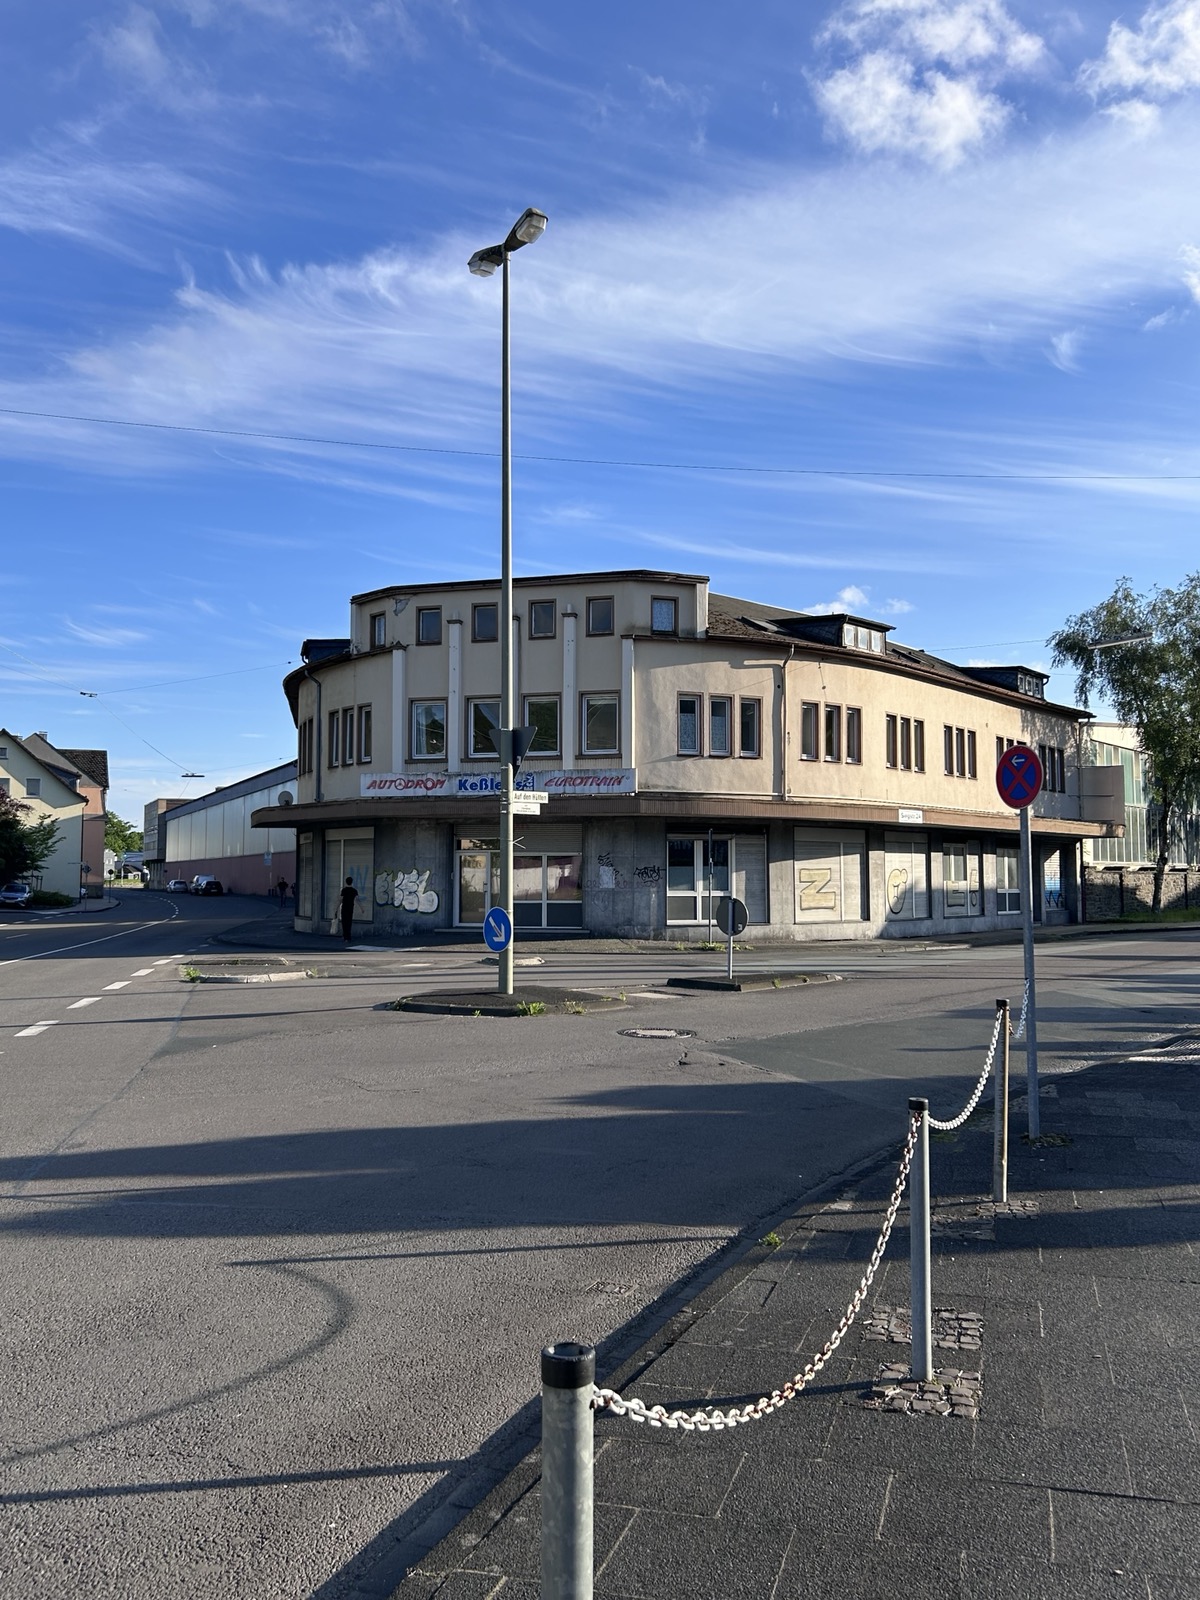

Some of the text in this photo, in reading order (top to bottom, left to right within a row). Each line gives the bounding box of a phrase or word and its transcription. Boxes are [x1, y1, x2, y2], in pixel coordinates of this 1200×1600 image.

[366, 777, 447, 791] AUTODROM
[544, 775, 625, 787] EUROTRAIN
[514, 792, 522, 800] Auf
[523, 792, 531, 800] den
